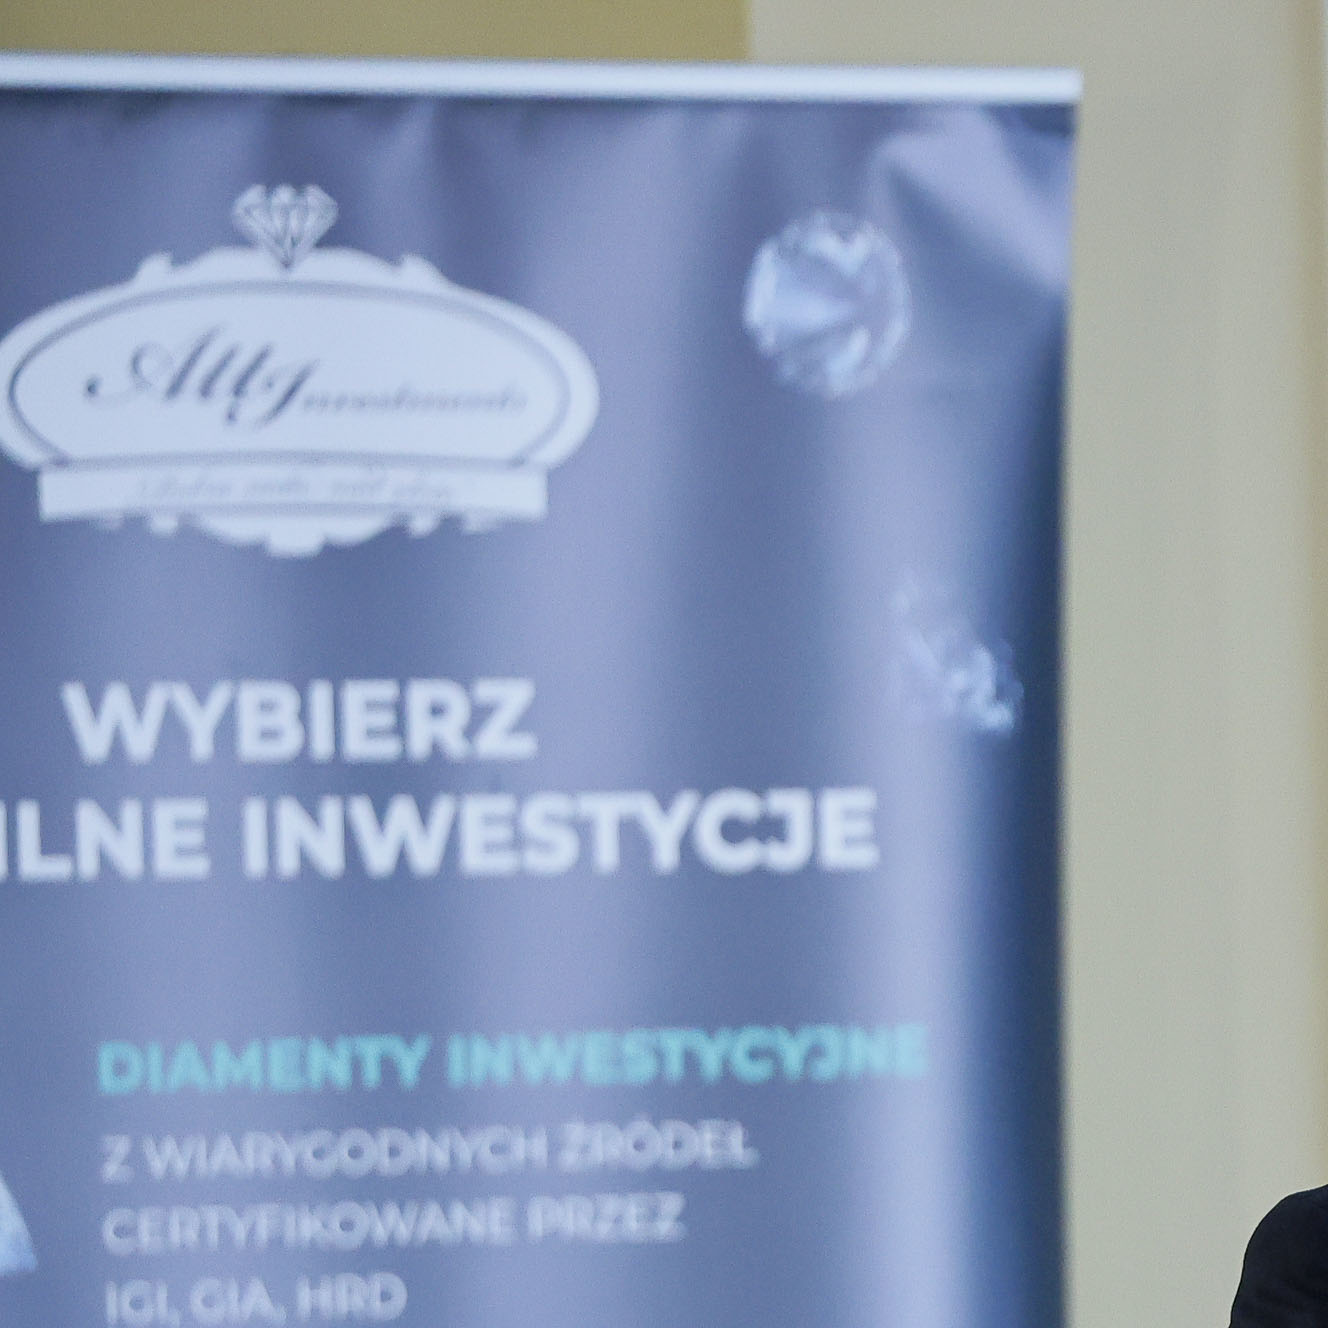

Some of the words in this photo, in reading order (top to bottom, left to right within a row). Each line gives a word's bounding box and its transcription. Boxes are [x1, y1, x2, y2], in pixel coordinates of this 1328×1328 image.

[62, 678, 538, 764] WYBIERZ
[243, 788, 882, 879] INWESTYCJE
[98, 1033, 432, 1094] DIAMENTY
[447, 1022, 930, 1087] INWESTYCYJNE
[103, 1132, 134, 1184] Z
[142, 1123, 548, 1182] WIARYGODNYCH
[102, 1197, 515, 1256] CERTYFIKOWANE
[526, 1191, 688, 1243] PRZEZ
[297, 1271, 408, 1322] HRD
